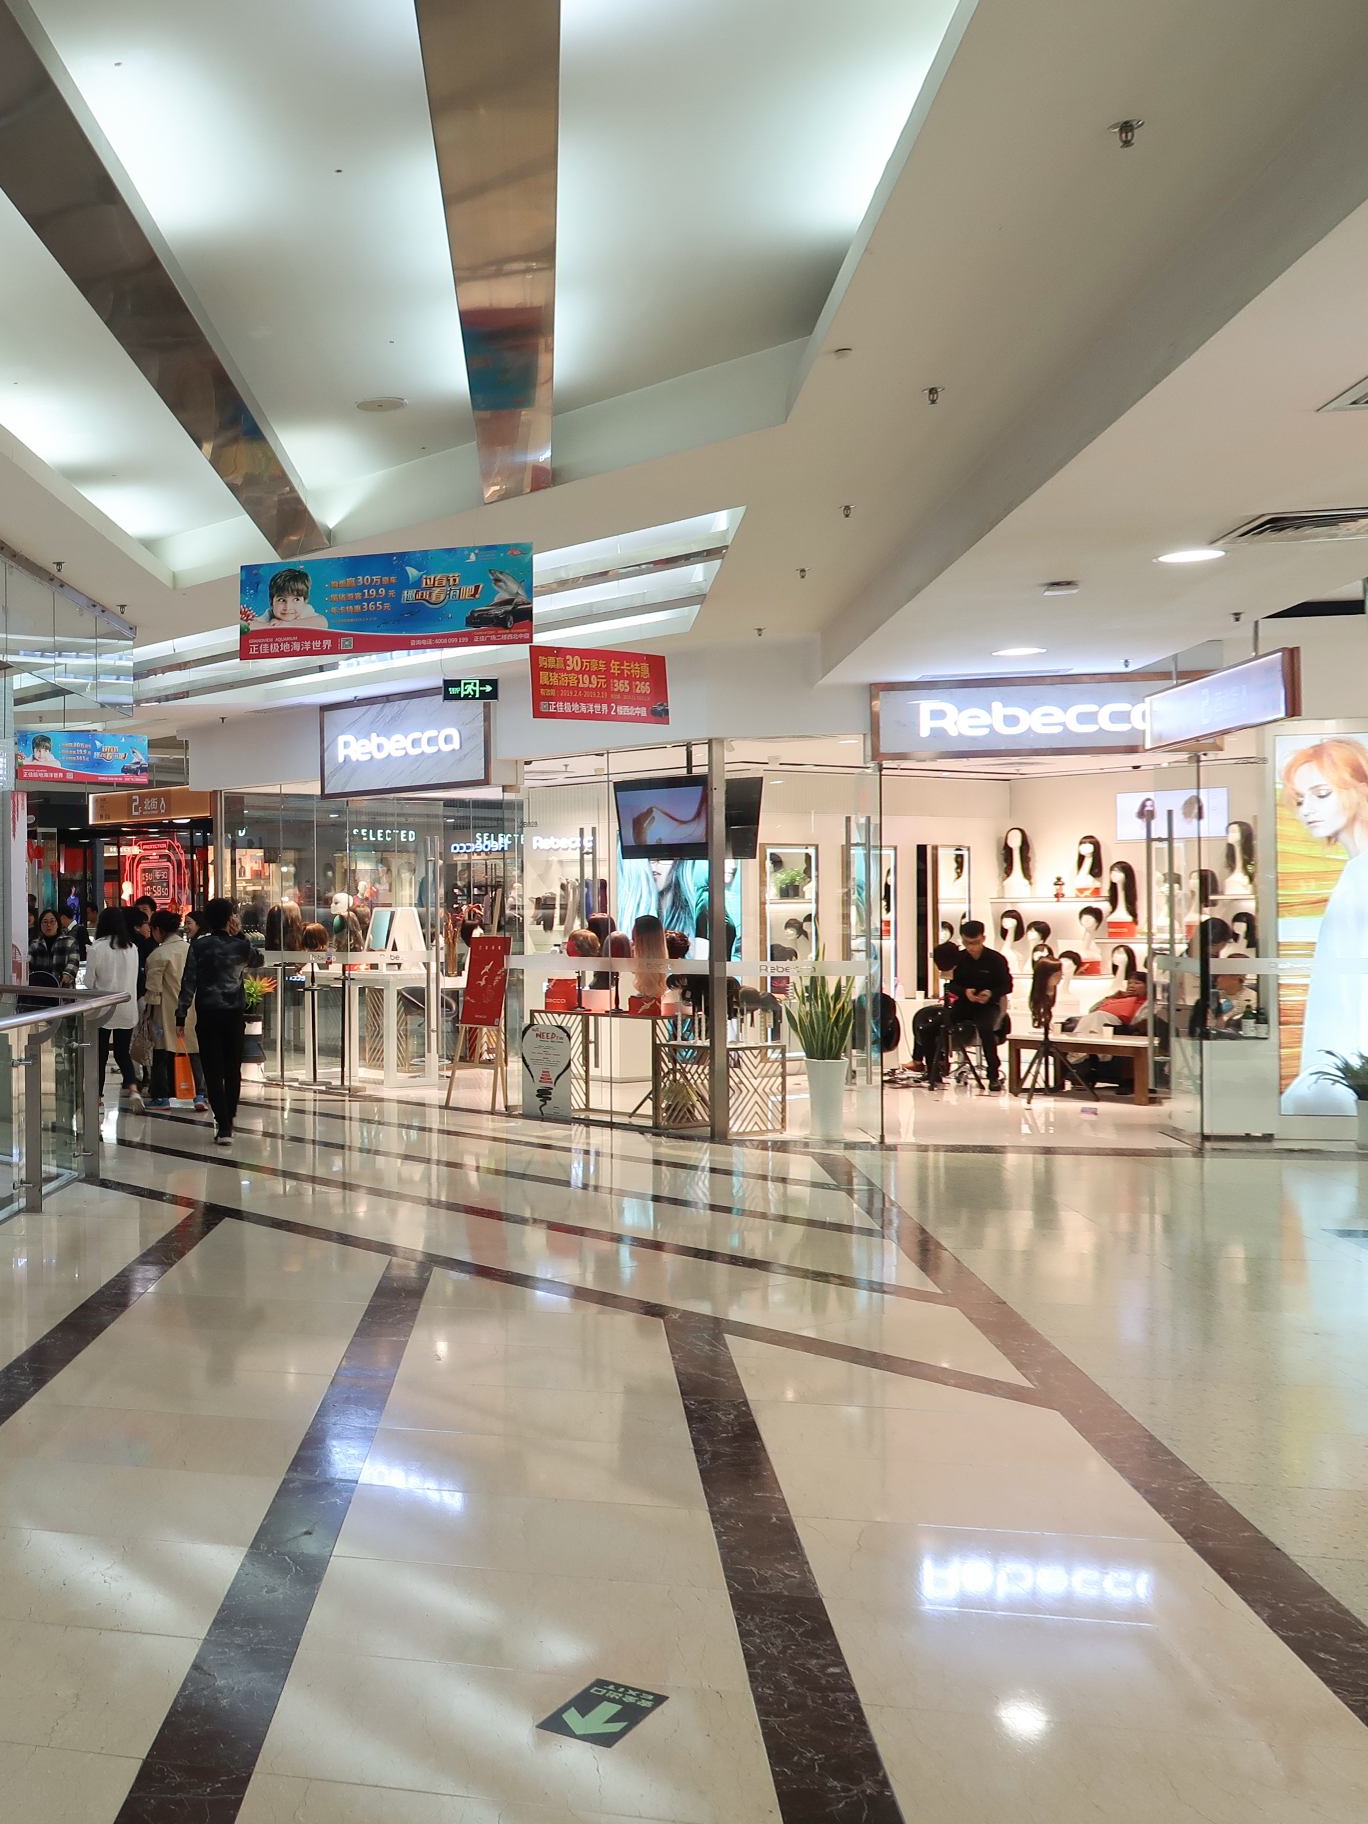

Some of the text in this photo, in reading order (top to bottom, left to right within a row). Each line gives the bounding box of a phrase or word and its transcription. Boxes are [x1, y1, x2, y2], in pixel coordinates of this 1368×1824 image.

[249, 639, 332, 654] 正佳极地海洋世界
[538, 655, 607, 672] 购票赢30万豪车
[610, 660, 651, 679] 年卡特惠
[539, 672, 607, 689] 属猪游客19.9元
[614, 680, 630, 693] 365
[635, 682, 651, 694] 266
[549, 701, 608, 715] 正佳极地海洋世界
[337, 727, 462, 764] Rebecca
[536, 1032, 556, 1040] NEED
